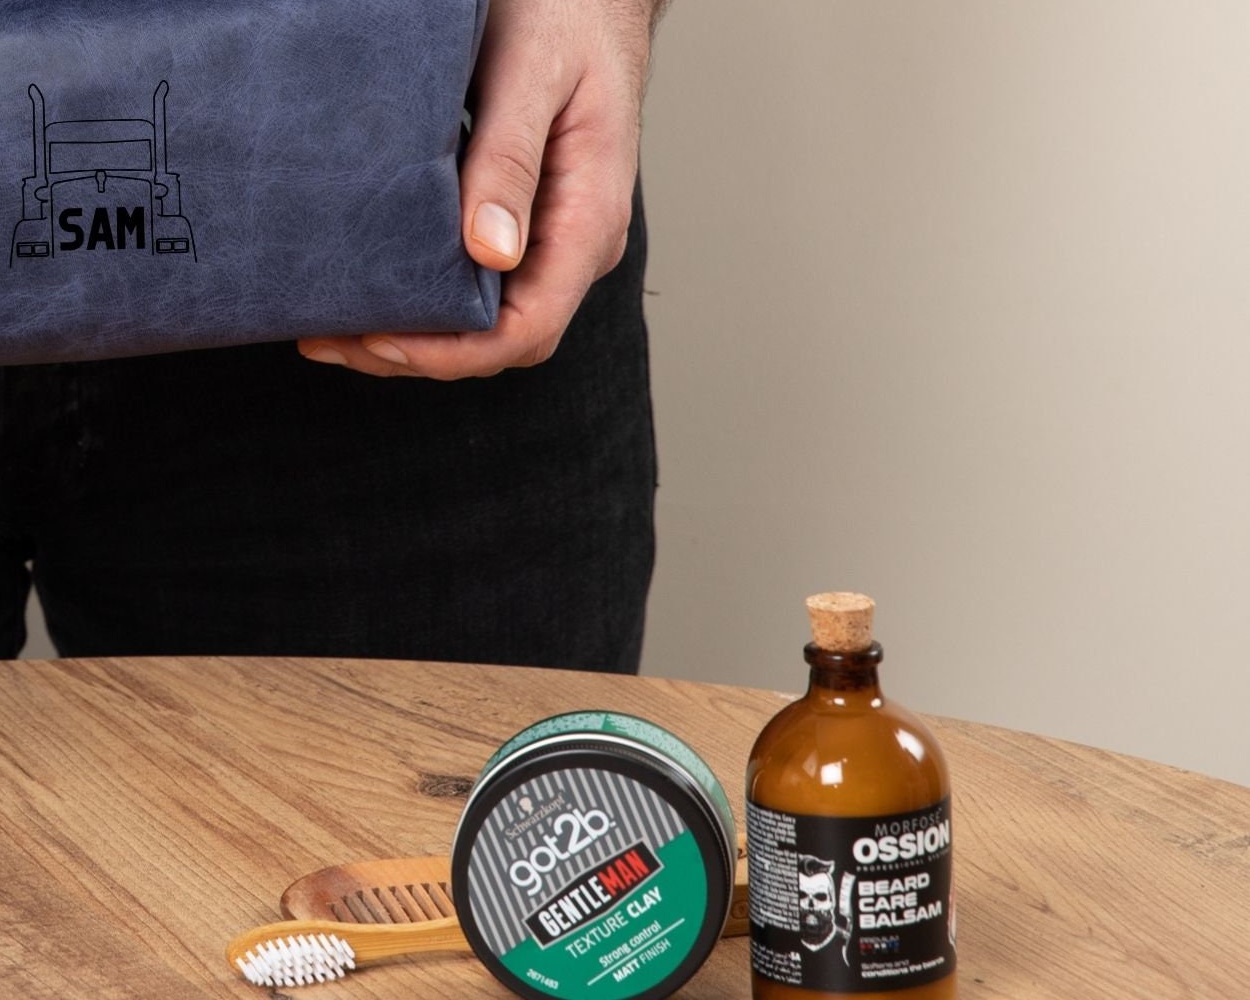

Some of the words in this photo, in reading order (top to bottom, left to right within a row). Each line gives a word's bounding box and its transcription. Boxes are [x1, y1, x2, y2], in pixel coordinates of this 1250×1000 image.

[58, 206, 146, 251] SAM
[504, 792, 566, 839] Schwarzkopf
[874, 811, 941, 837] MORFOSE
[852, 819, 950, 864] OSSION
[538, 850, 650, 937] GENTLEMAN
[858, 872, 930, 896] BEARD
[858, 891, 918, 912] CARE
[565, 910, 629, 959] TEXTURE
[626, 886, 663, 918] CLAY
[859, 900, 943, 929] BALSAM
[598, 943, 631, 968] Strong
[629, 920, 662, 948] control
[612, 959, 640, 983] MATT
[639, 938, 671, 965] FINISH
